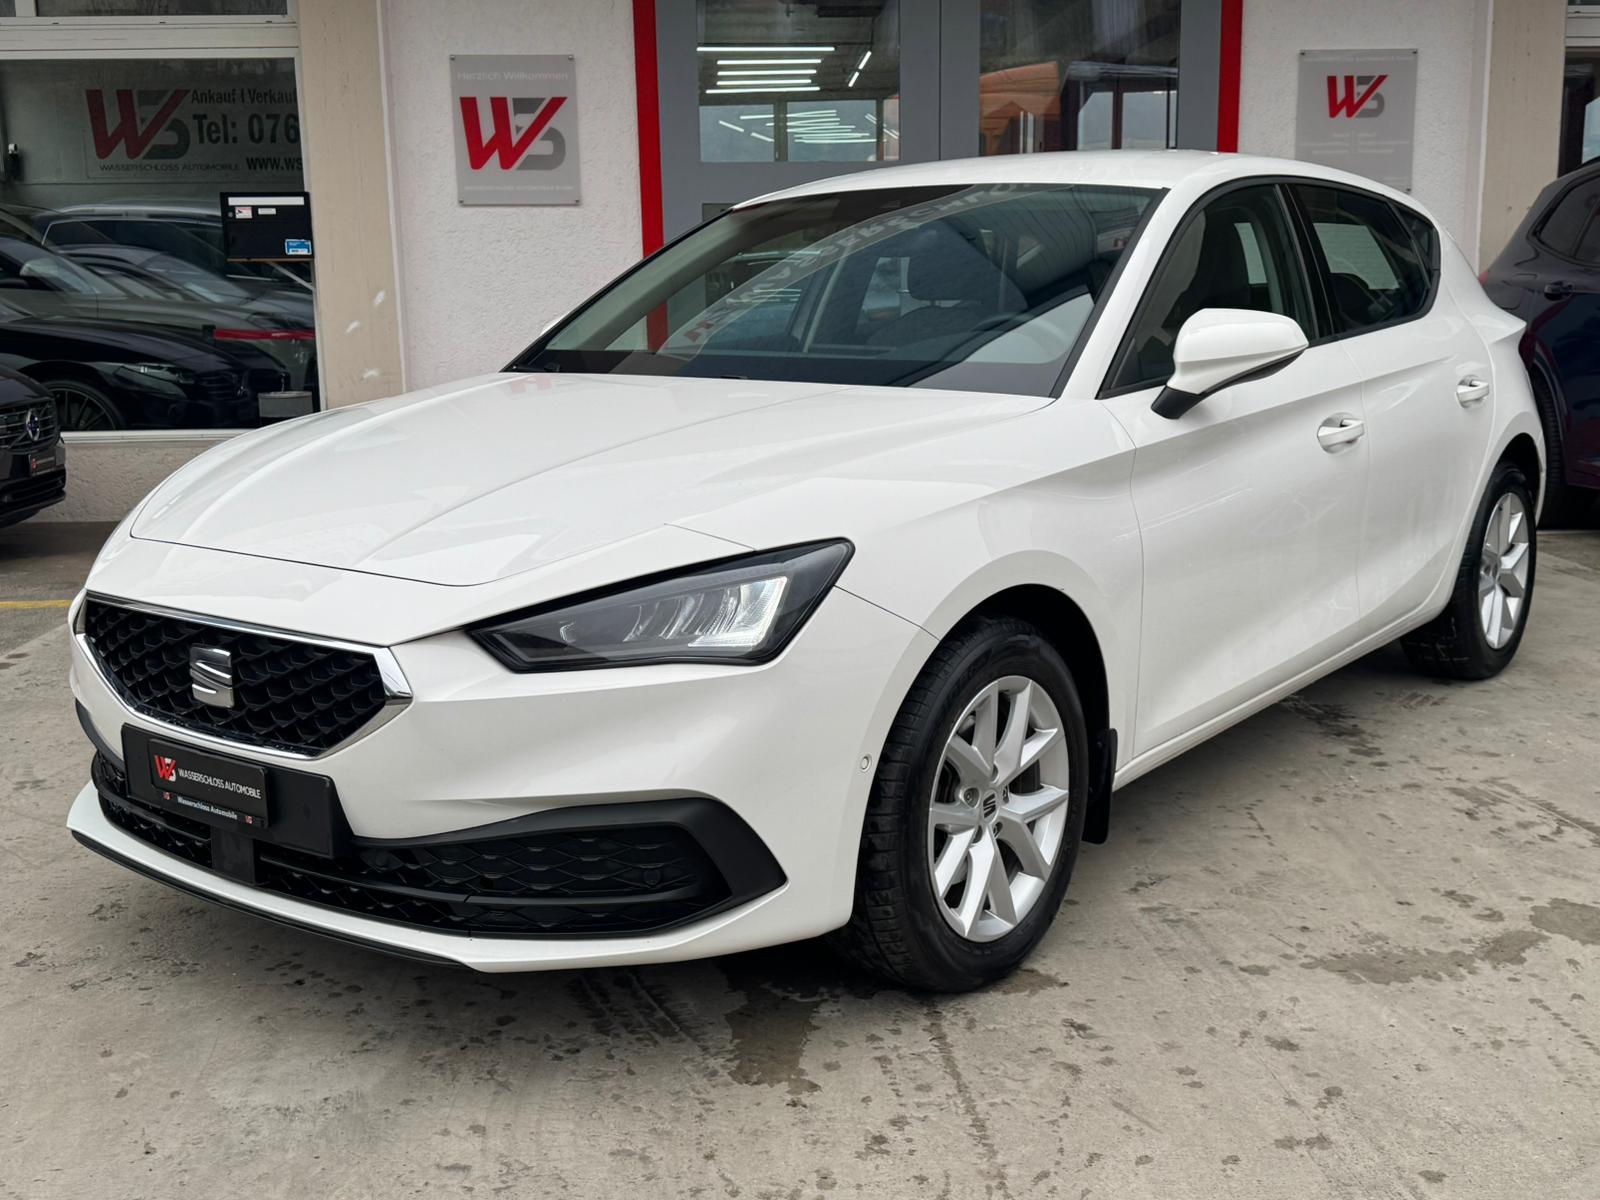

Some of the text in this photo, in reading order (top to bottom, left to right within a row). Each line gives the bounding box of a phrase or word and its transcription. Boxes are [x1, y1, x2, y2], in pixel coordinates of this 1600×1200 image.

[503, 71, 569, 81] Willkommen
[191, 88, 236, 104] Ankauf
[192, 112, 300, 145] Tel: 076
[98, 163, 240, 172] WASSERSCHLOSS AUTOMOBILE
[178, 768, 261, 799] WASSERSCHLOSS AUTOMOBILE
[177, 796, 238, 820] Wasserschloss Automobile
